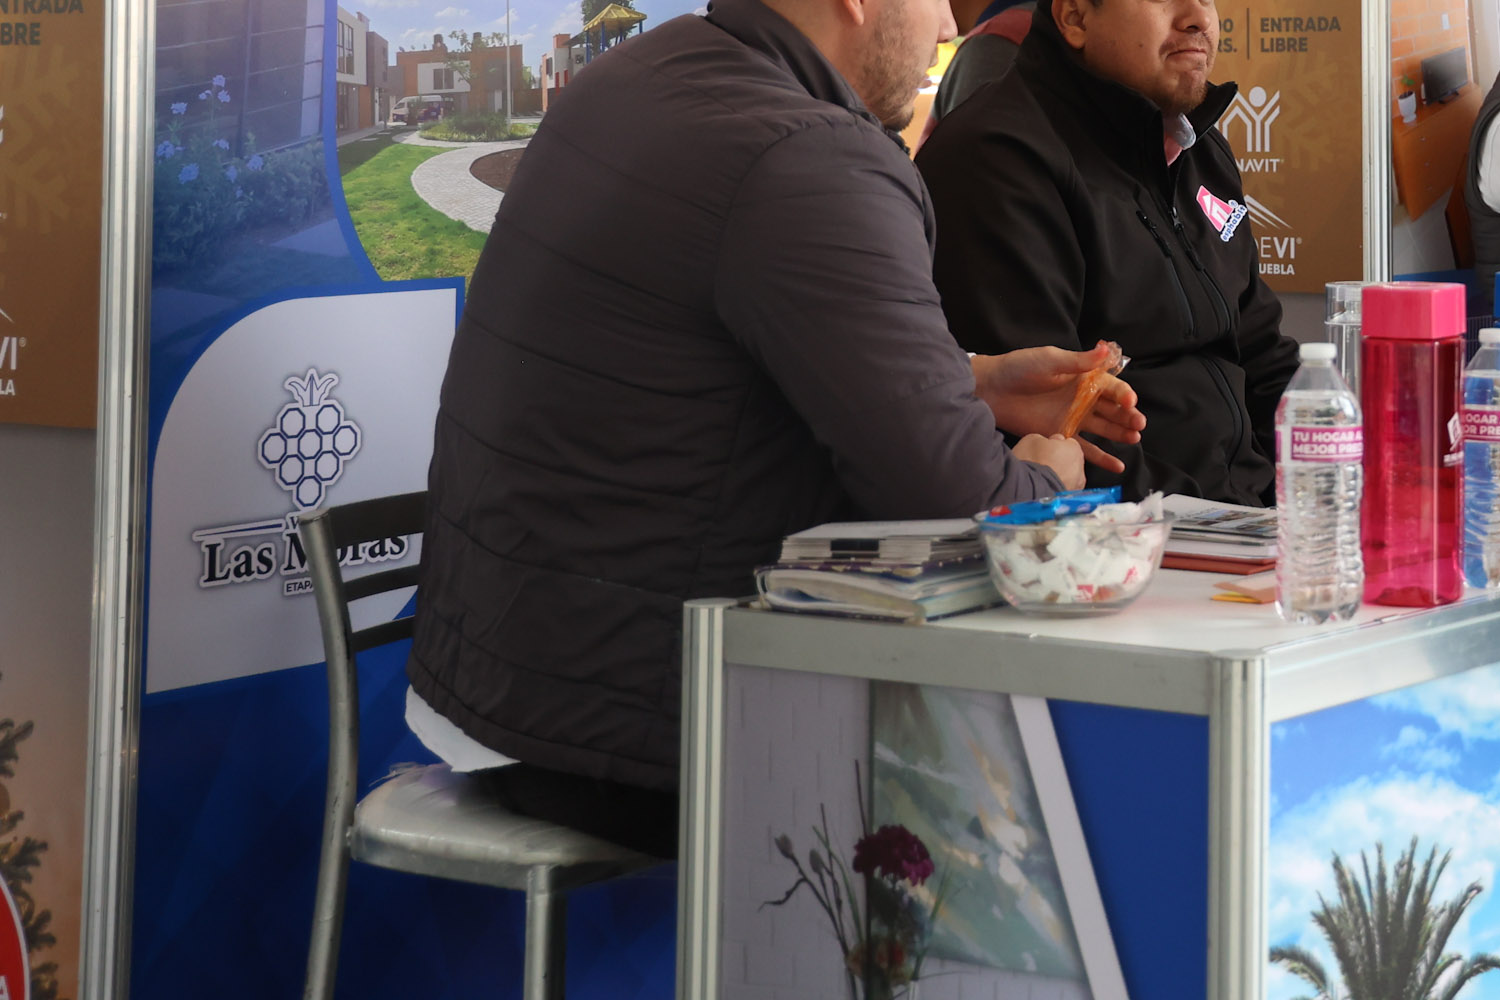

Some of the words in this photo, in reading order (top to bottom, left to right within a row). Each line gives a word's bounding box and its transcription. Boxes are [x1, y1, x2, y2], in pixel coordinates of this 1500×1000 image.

[1261, 16, 1342, 33] ENTRADA
[1261, 37, 1308, 53] LIBRE
[1221, 204, 1248, 241] esphabit
[1293, 431, 1310, 442] TU
[1312, 431, 1354, 442] HOGAR
[1292, 443, 1337, 454] MEJOR
[203, 542, 275, 584] Las
